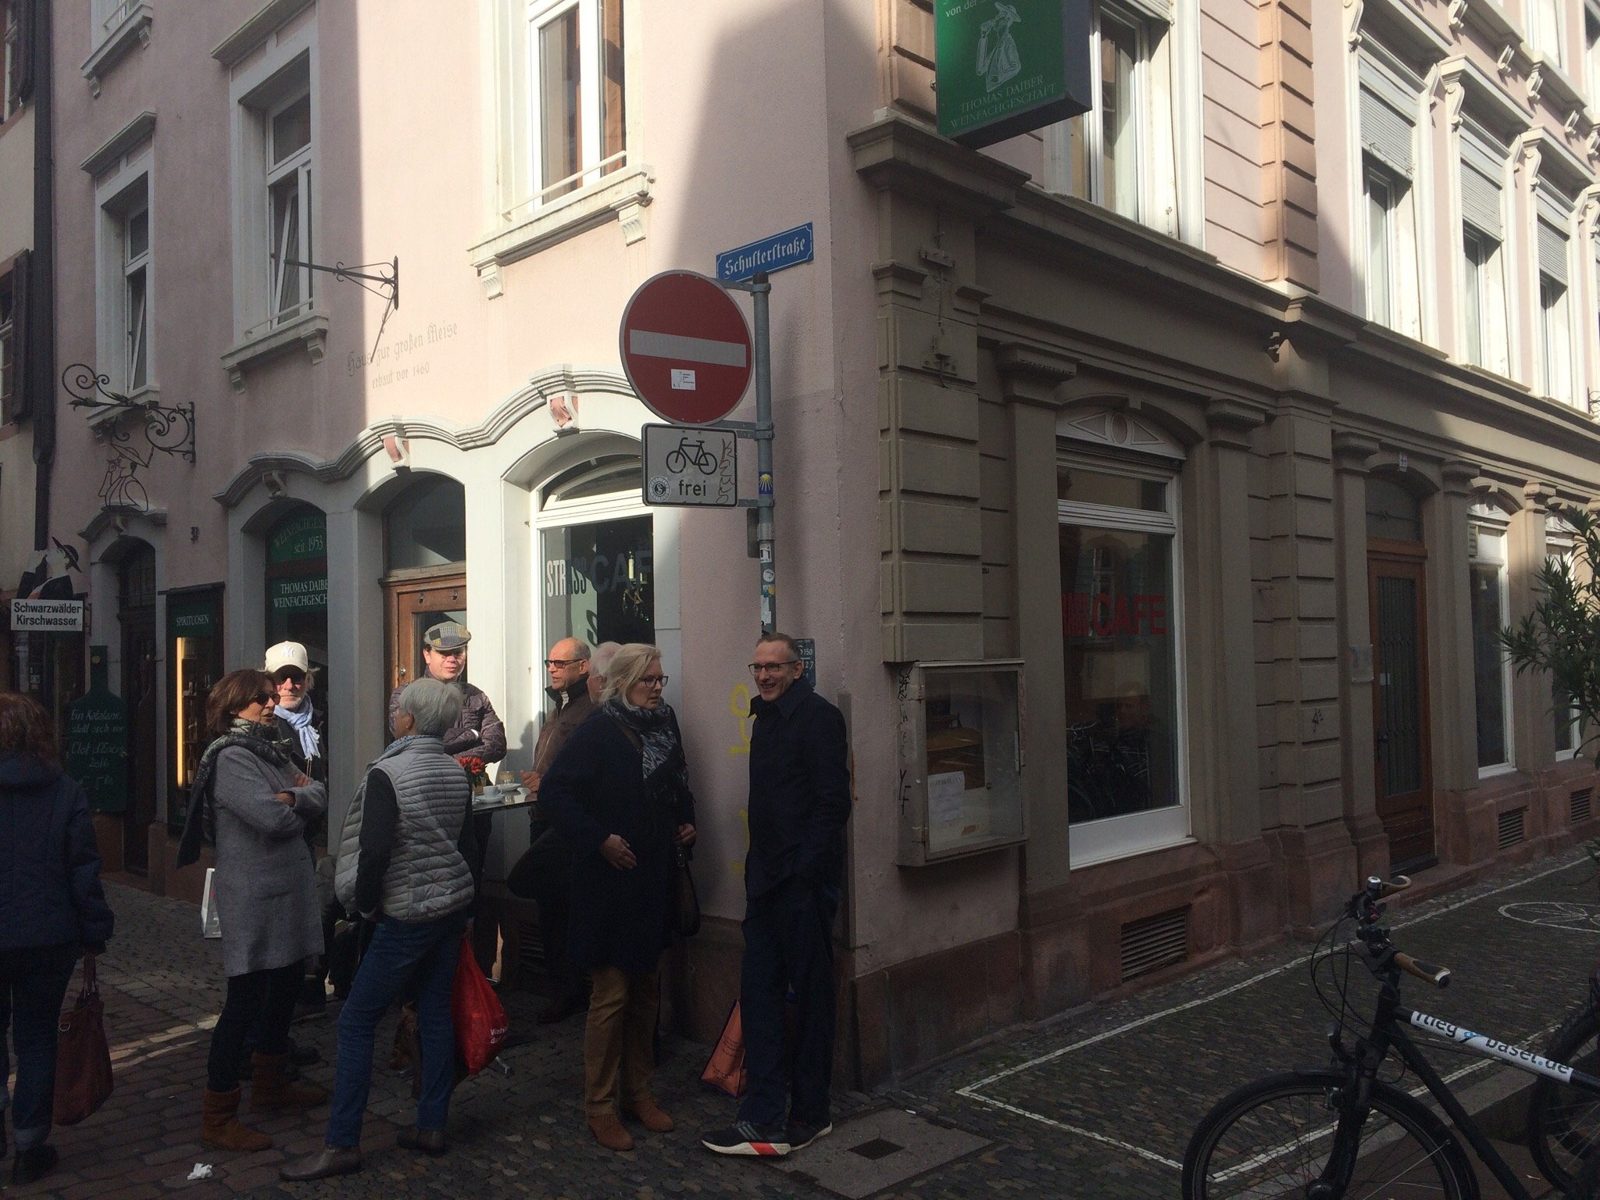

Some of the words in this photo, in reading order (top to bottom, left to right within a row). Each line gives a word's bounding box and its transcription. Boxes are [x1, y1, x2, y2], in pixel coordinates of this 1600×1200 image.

[945, 6, 961, 18] von
[960, 91, 1004, 112] THOMAS
[1006, 74, 1045, 96] DAIBER
[376, 345, 390, 367] zur
[426, 320, 458, 344] Meise
[396, 368, 409, 381] vor
[678, 480, 706, 496] frei
[280, 582, 308, 594] THOMAS
[14, 602, 82, 614] Schwarzwälder
[16, 614, 77, 626] Kirschwasser
[176, 614, 209, 627] SPIRITUOSEN
